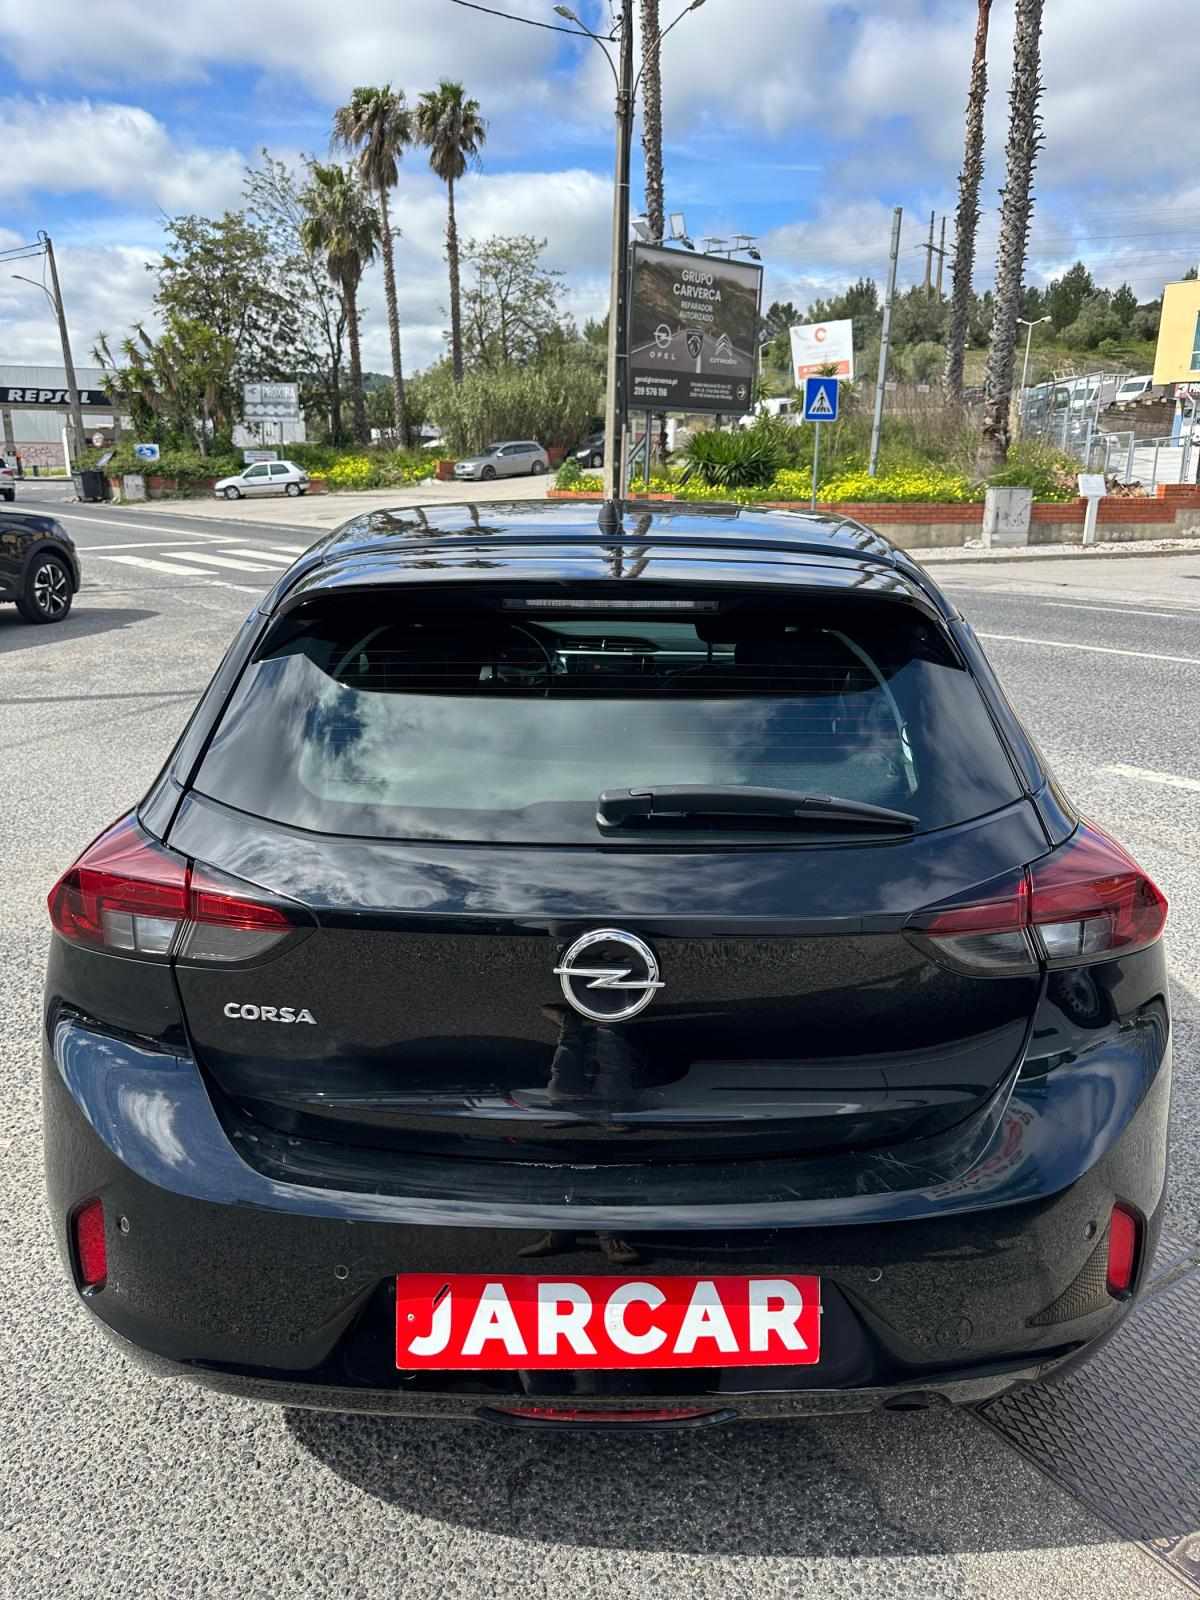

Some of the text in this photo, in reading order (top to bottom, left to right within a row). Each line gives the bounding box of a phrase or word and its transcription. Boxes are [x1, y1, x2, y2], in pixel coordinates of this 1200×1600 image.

[681, 269, 713, 286] GRUPO
[672, 283, 722, 303] CARVERCA
[680, 300, 713, 313] REPARADOR
[679, 310, 714, 322] AUTORIZADO
[648, 350, 677, 360] OPEL
[223, 1002, 318, 1025] CORSA
[408, 1278, 809, 1357] JARCAR
